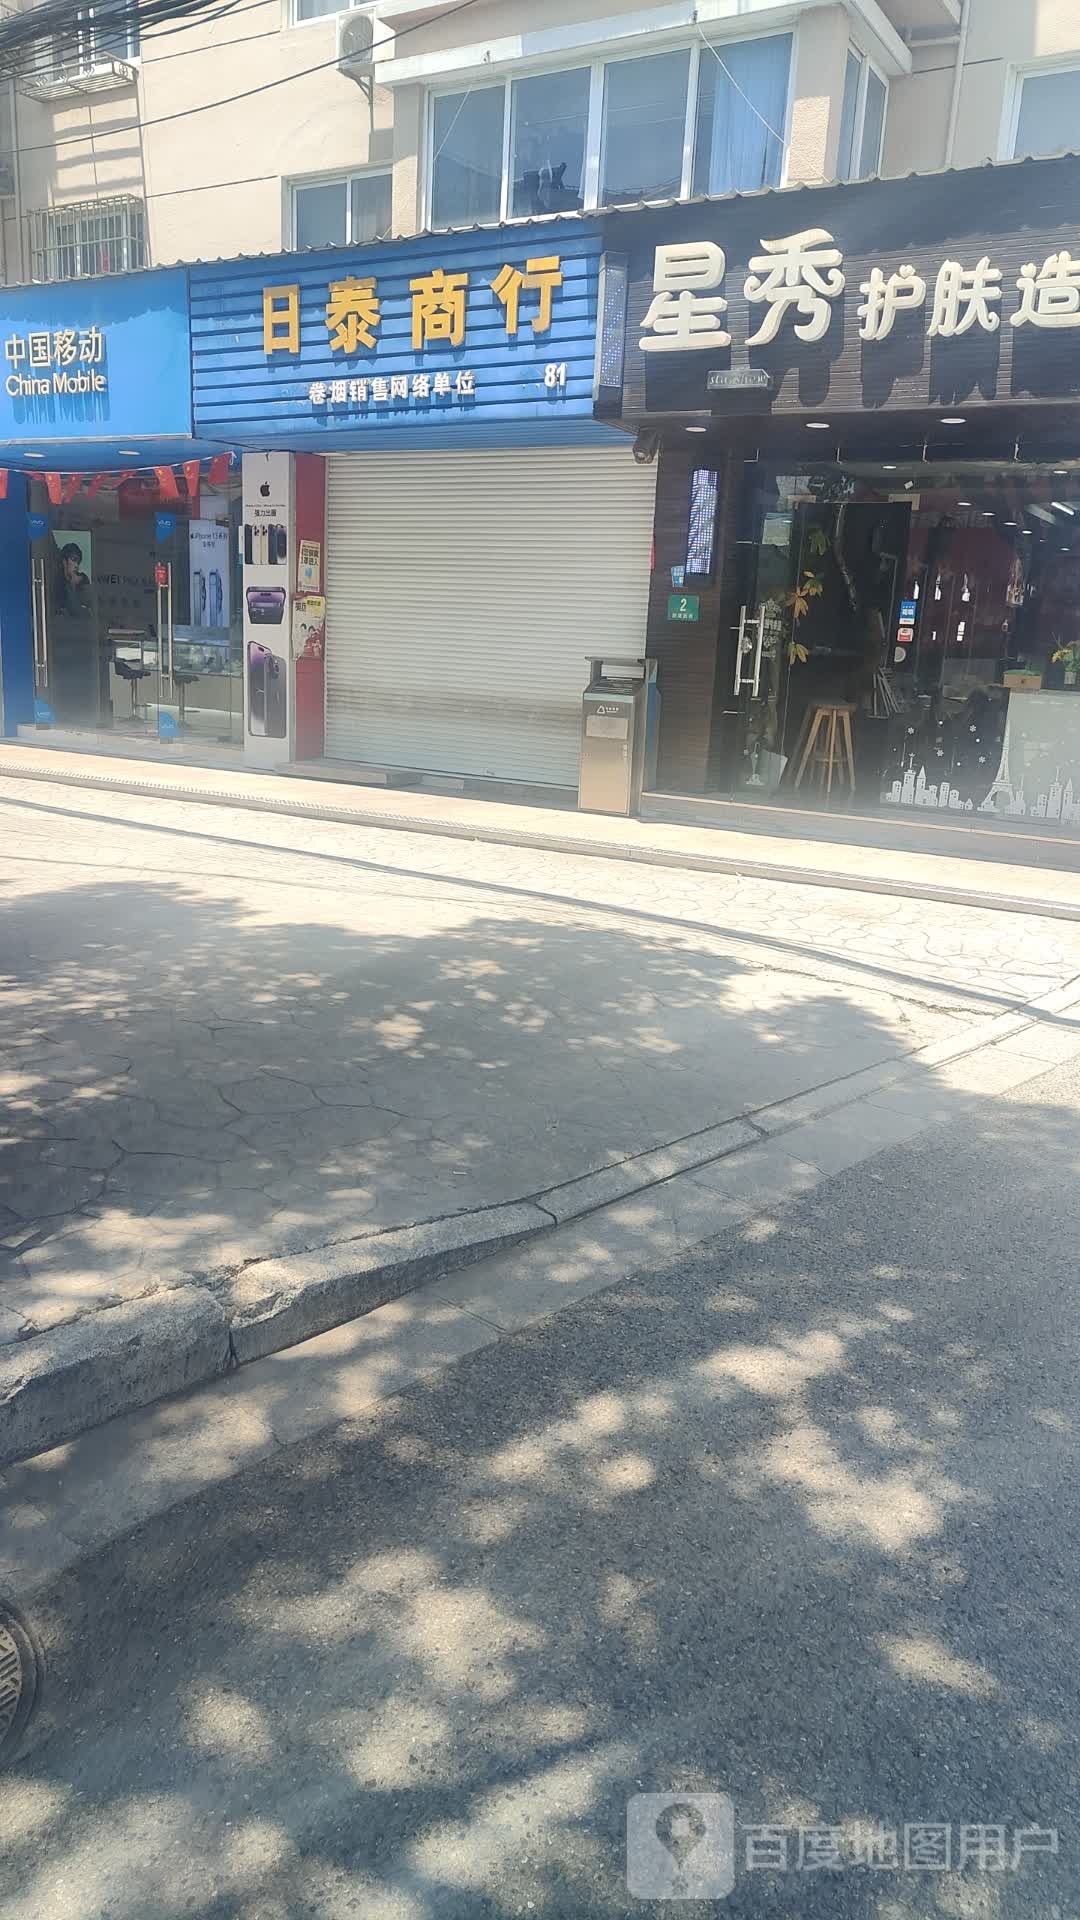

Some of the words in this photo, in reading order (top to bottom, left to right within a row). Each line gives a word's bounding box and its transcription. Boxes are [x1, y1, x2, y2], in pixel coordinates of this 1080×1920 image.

[263, 255, 563, 355] 日泰商行
[5, 326, 103, 369] 中国移动
[6, 373, 50, 396] China
[53, 368, 107, 394] Mobile
[309, 370, 475, 404] 卷烟销售网络单位
[544, 362, 567, 388] 81
[679, 598, 687, 612] 2
